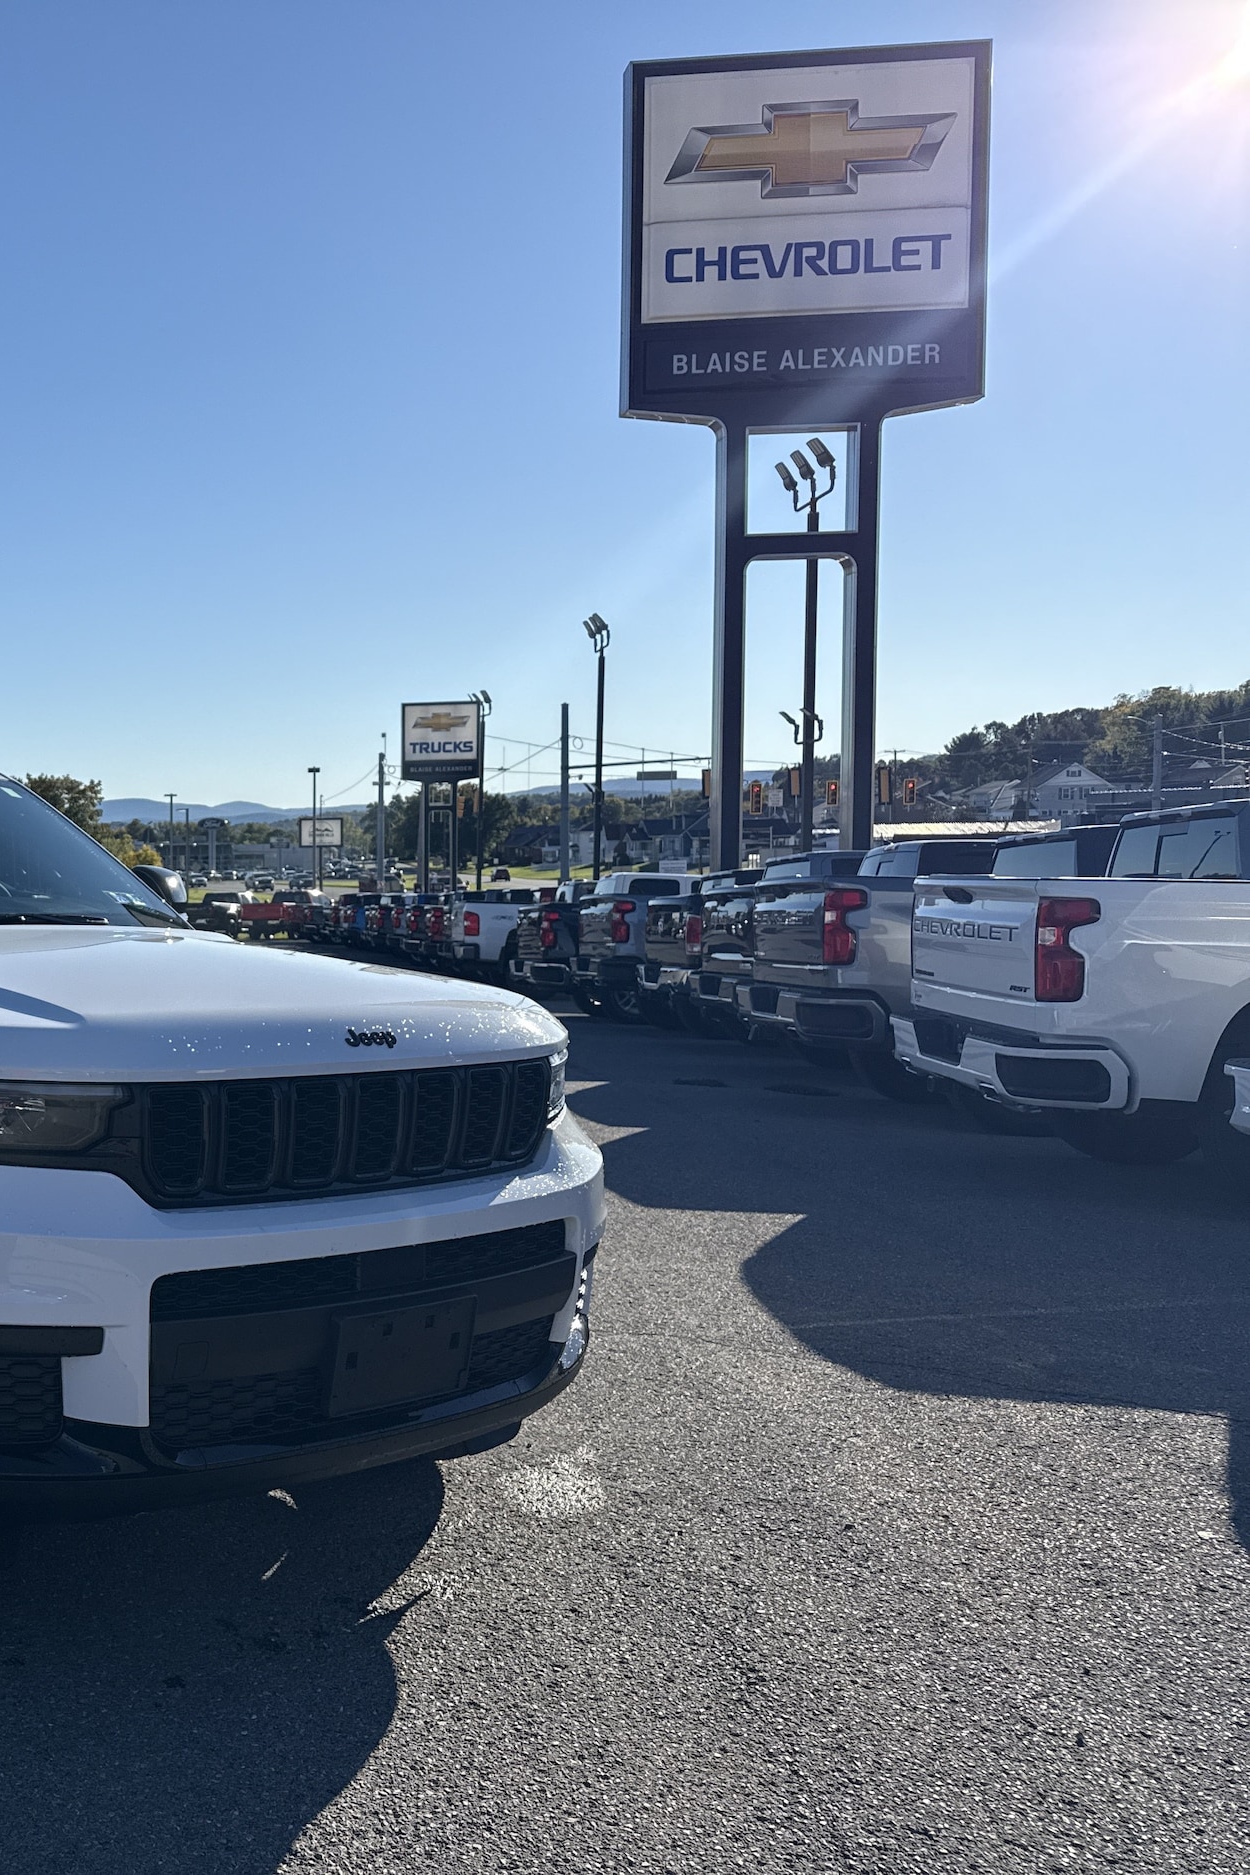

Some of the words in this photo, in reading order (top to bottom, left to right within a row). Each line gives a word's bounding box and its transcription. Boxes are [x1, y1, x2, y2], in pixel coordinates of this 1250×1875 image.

[664, 233, 952, 284] CHEVROLET
[672, 350, 768, 375] BLAISE
[778, 343, 941, 371] ALEXANDER
[409, 740, 474, 755] TRUCKS
[913, 919, 1020, 942] CHEVROLET
[1009, 984, 1031, 993] RST
[344, 1028, 398, 1049] Jeep
